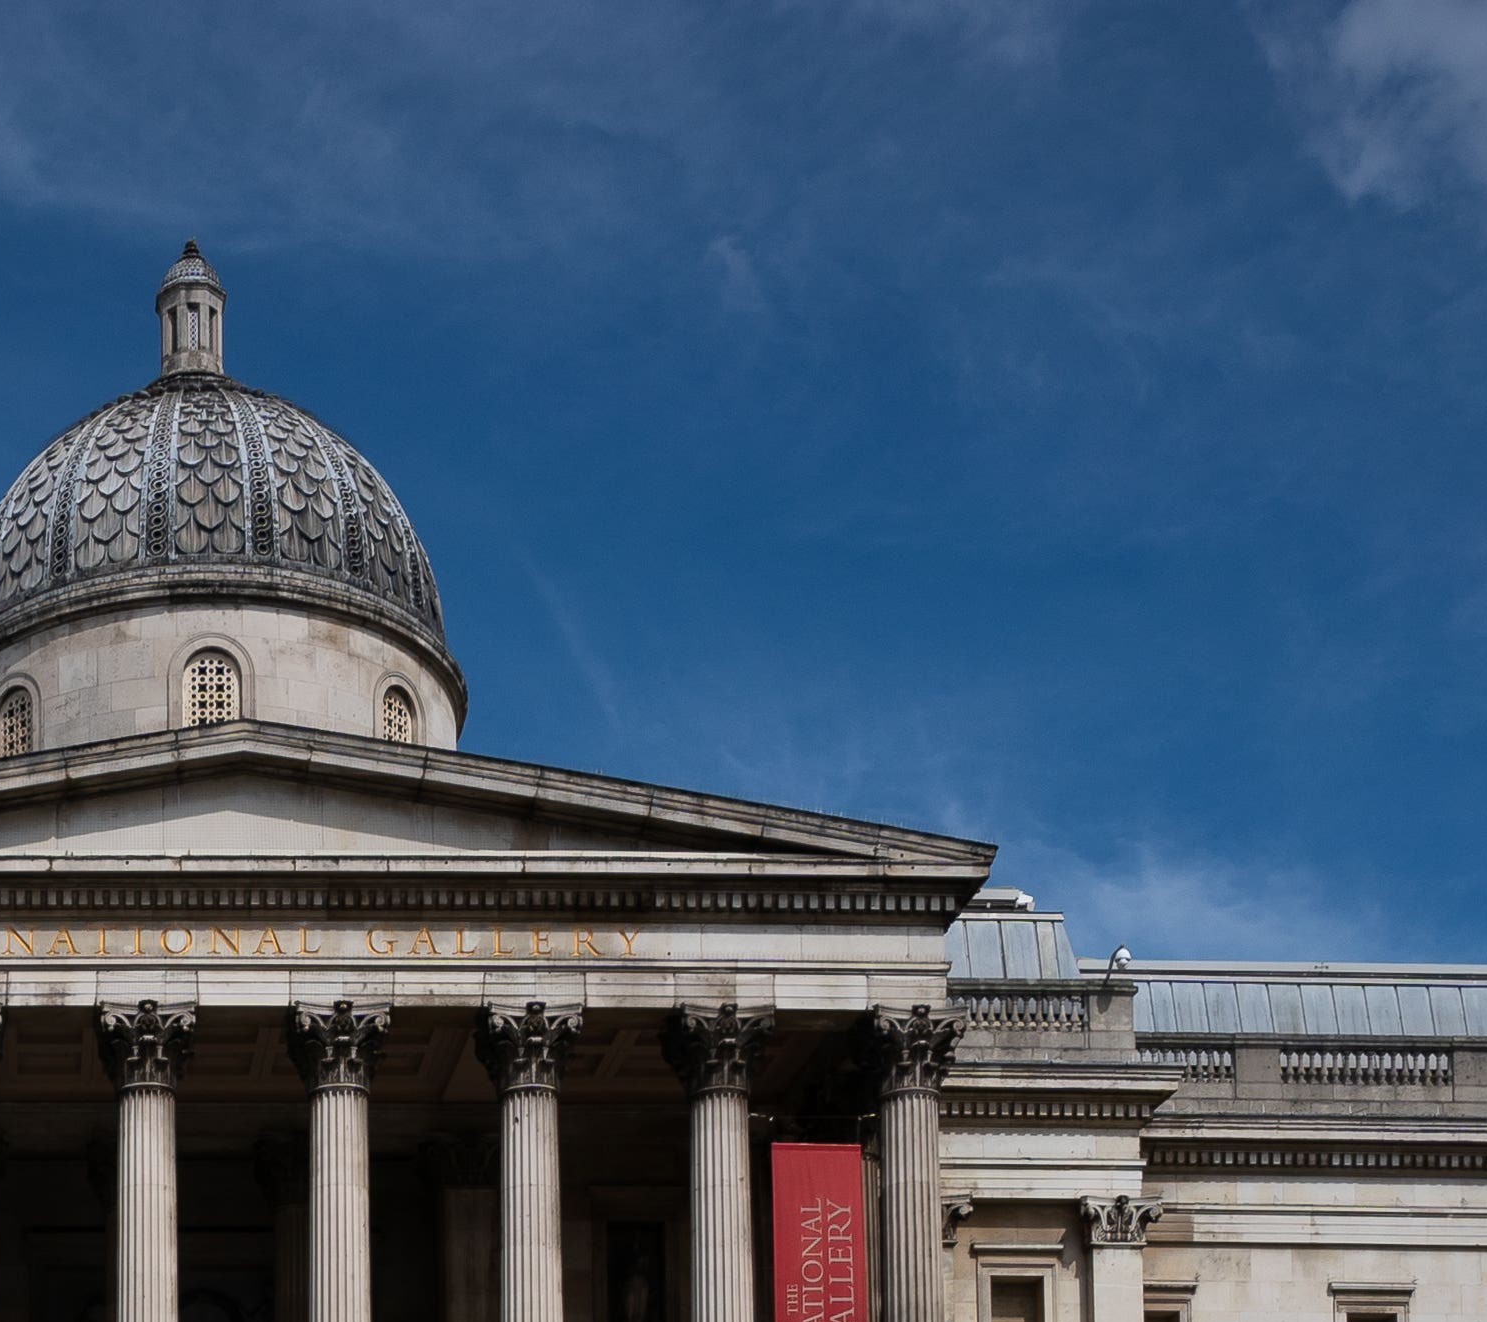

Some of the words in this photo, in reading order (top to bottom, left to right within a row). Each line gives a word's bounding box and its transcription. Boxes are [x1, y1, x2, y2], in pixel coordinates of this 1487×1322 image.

[1, 926, 321, 956] NATIONAL
[365, 926, 641, 957] GALLERY
[787, 1283, 798, 1315] THE
